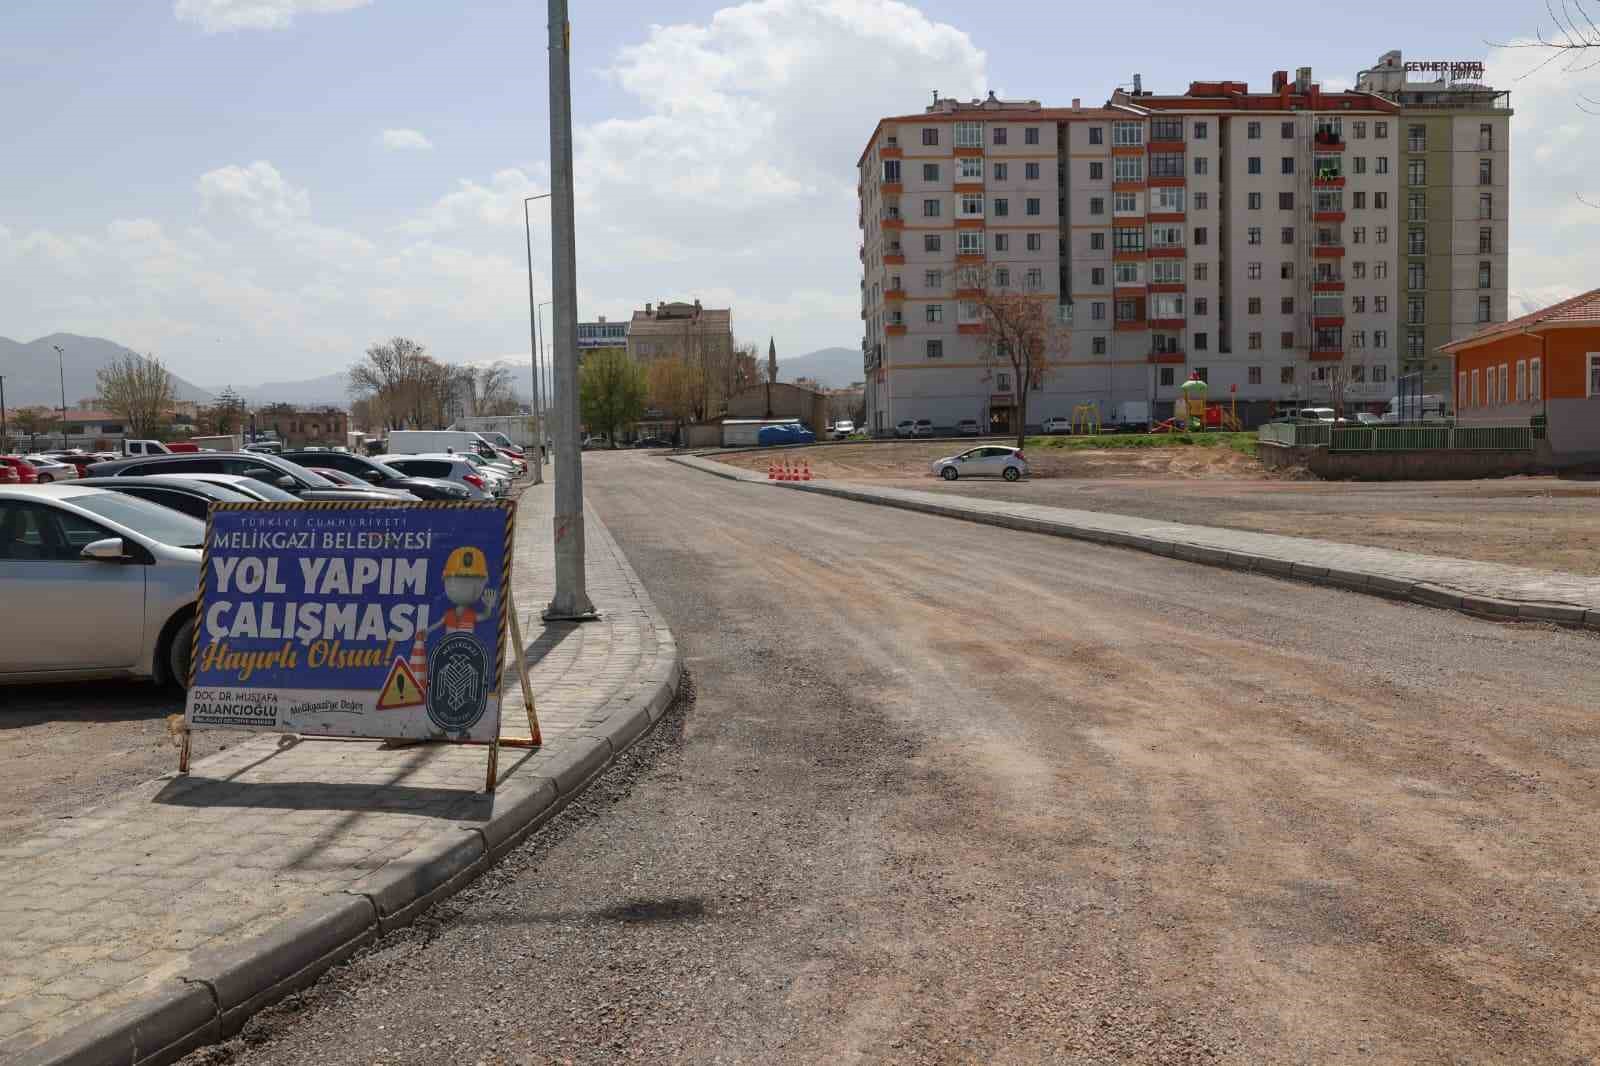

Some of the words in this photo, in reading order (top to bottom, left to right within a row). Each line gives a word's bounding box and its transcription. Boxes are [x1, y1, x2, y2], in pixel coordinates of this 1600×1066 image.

[1404, 61, 1448, 72] GEVHER
[1450, 61, 1485, 72] HOTEL
[213, 529, 316, 549] MELİKGAZİ
[322, 528, 432, 550] BELEDİYESİ
[212, 556, 287, 594] YOL
[299, 557, 429, 595] YAPIM
[206, 600, 430, 645] ÇALIŞMASI
[307, 638, 396, 669] Olsun!
[193, 703, 279, 717] PALANCIOĞLU
